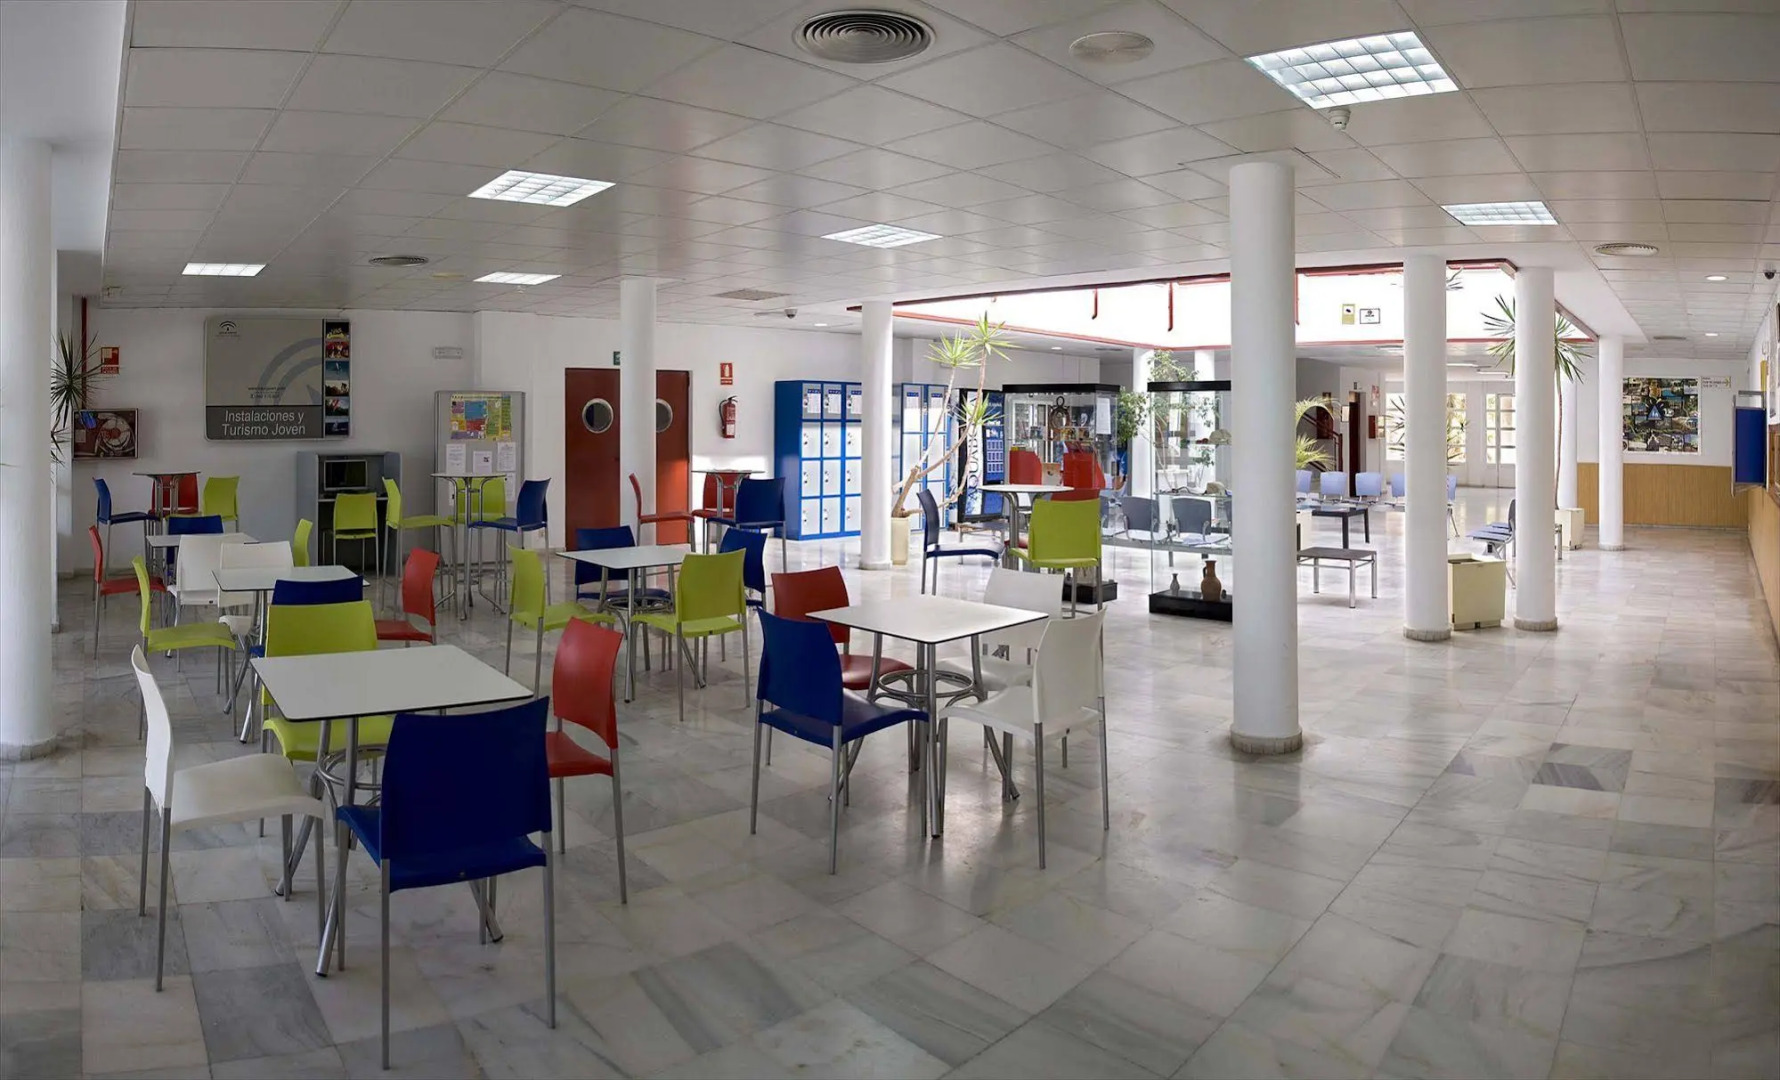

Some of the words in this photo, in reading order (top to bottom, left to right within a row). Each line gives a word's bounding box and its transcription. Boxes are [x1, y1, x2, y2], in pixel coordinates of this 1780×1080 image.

[225, 410, 295, 422] Instalaciones
[298, 411, 304, 424] y
[222, 423, 269, 436] Turismo
[271, 423, 306, 436] Joven
